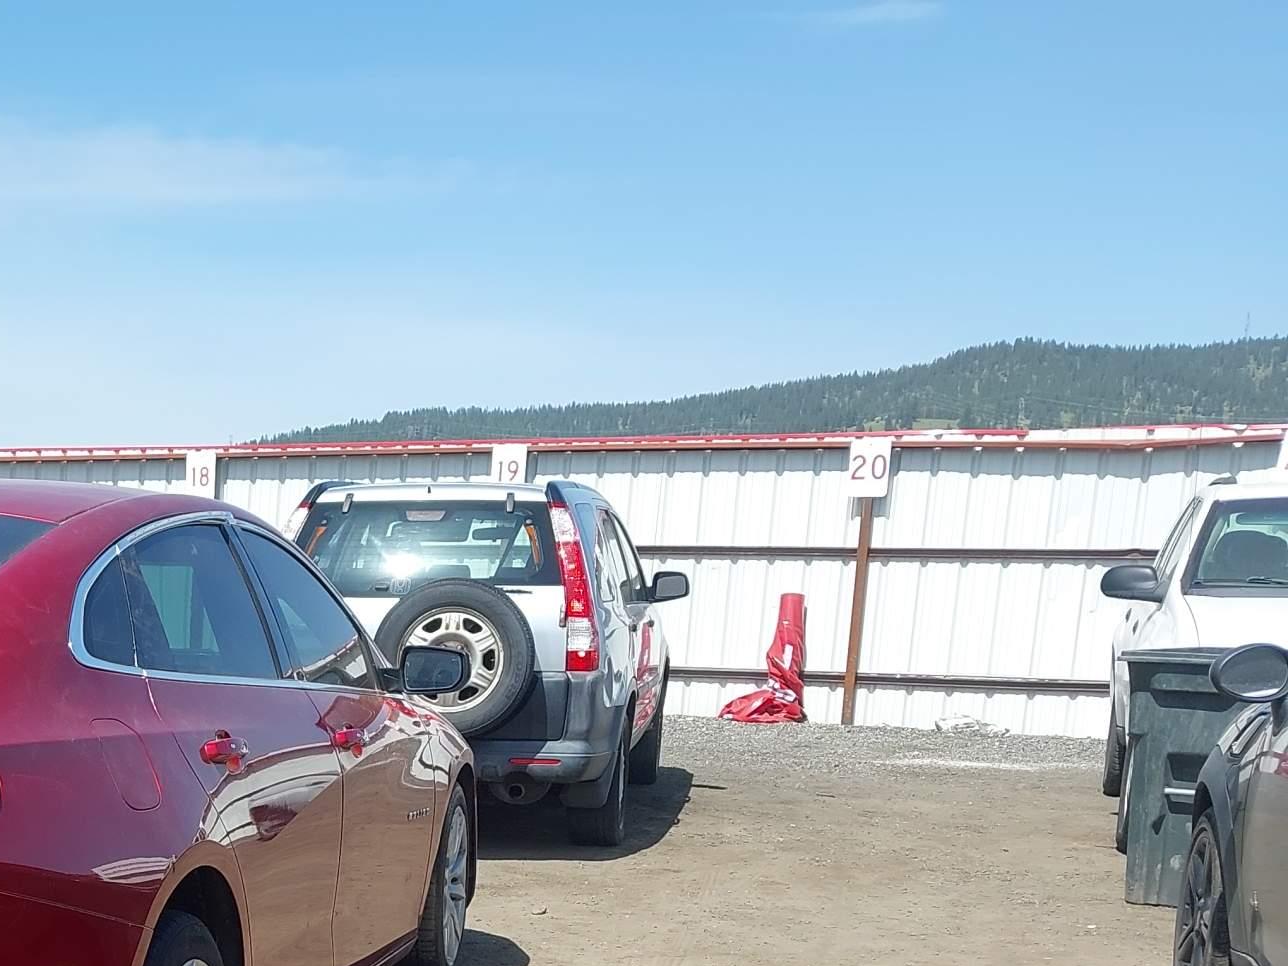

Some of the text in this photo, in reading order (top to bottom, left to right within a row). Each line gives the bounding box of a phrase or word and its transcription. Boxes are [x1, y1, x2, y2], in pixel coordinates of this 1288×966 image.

[192, 466, 209, 487] 18
[498, 460, 519, 482] 19
[851, 454, 887, 480] 20
